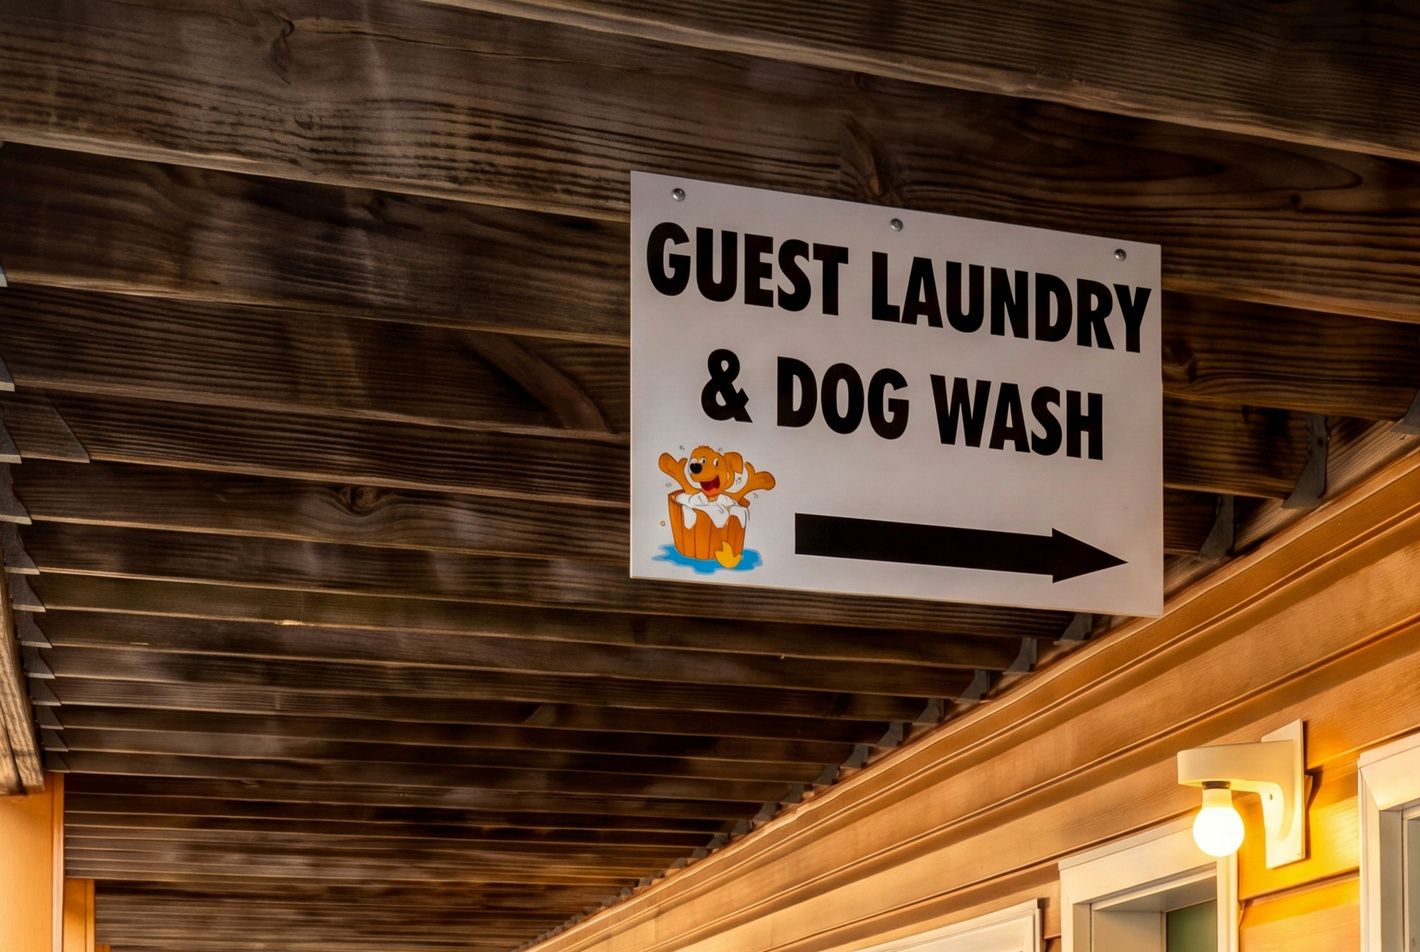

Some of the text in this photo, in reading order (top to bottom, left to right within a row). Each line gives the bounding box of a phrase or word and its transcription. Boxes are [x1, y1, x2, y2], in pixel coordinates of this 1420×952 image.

[646, 221, 1153, 354] GUEST LAUNDRY
[700, 348, 1104, 461] & DOG WASH
